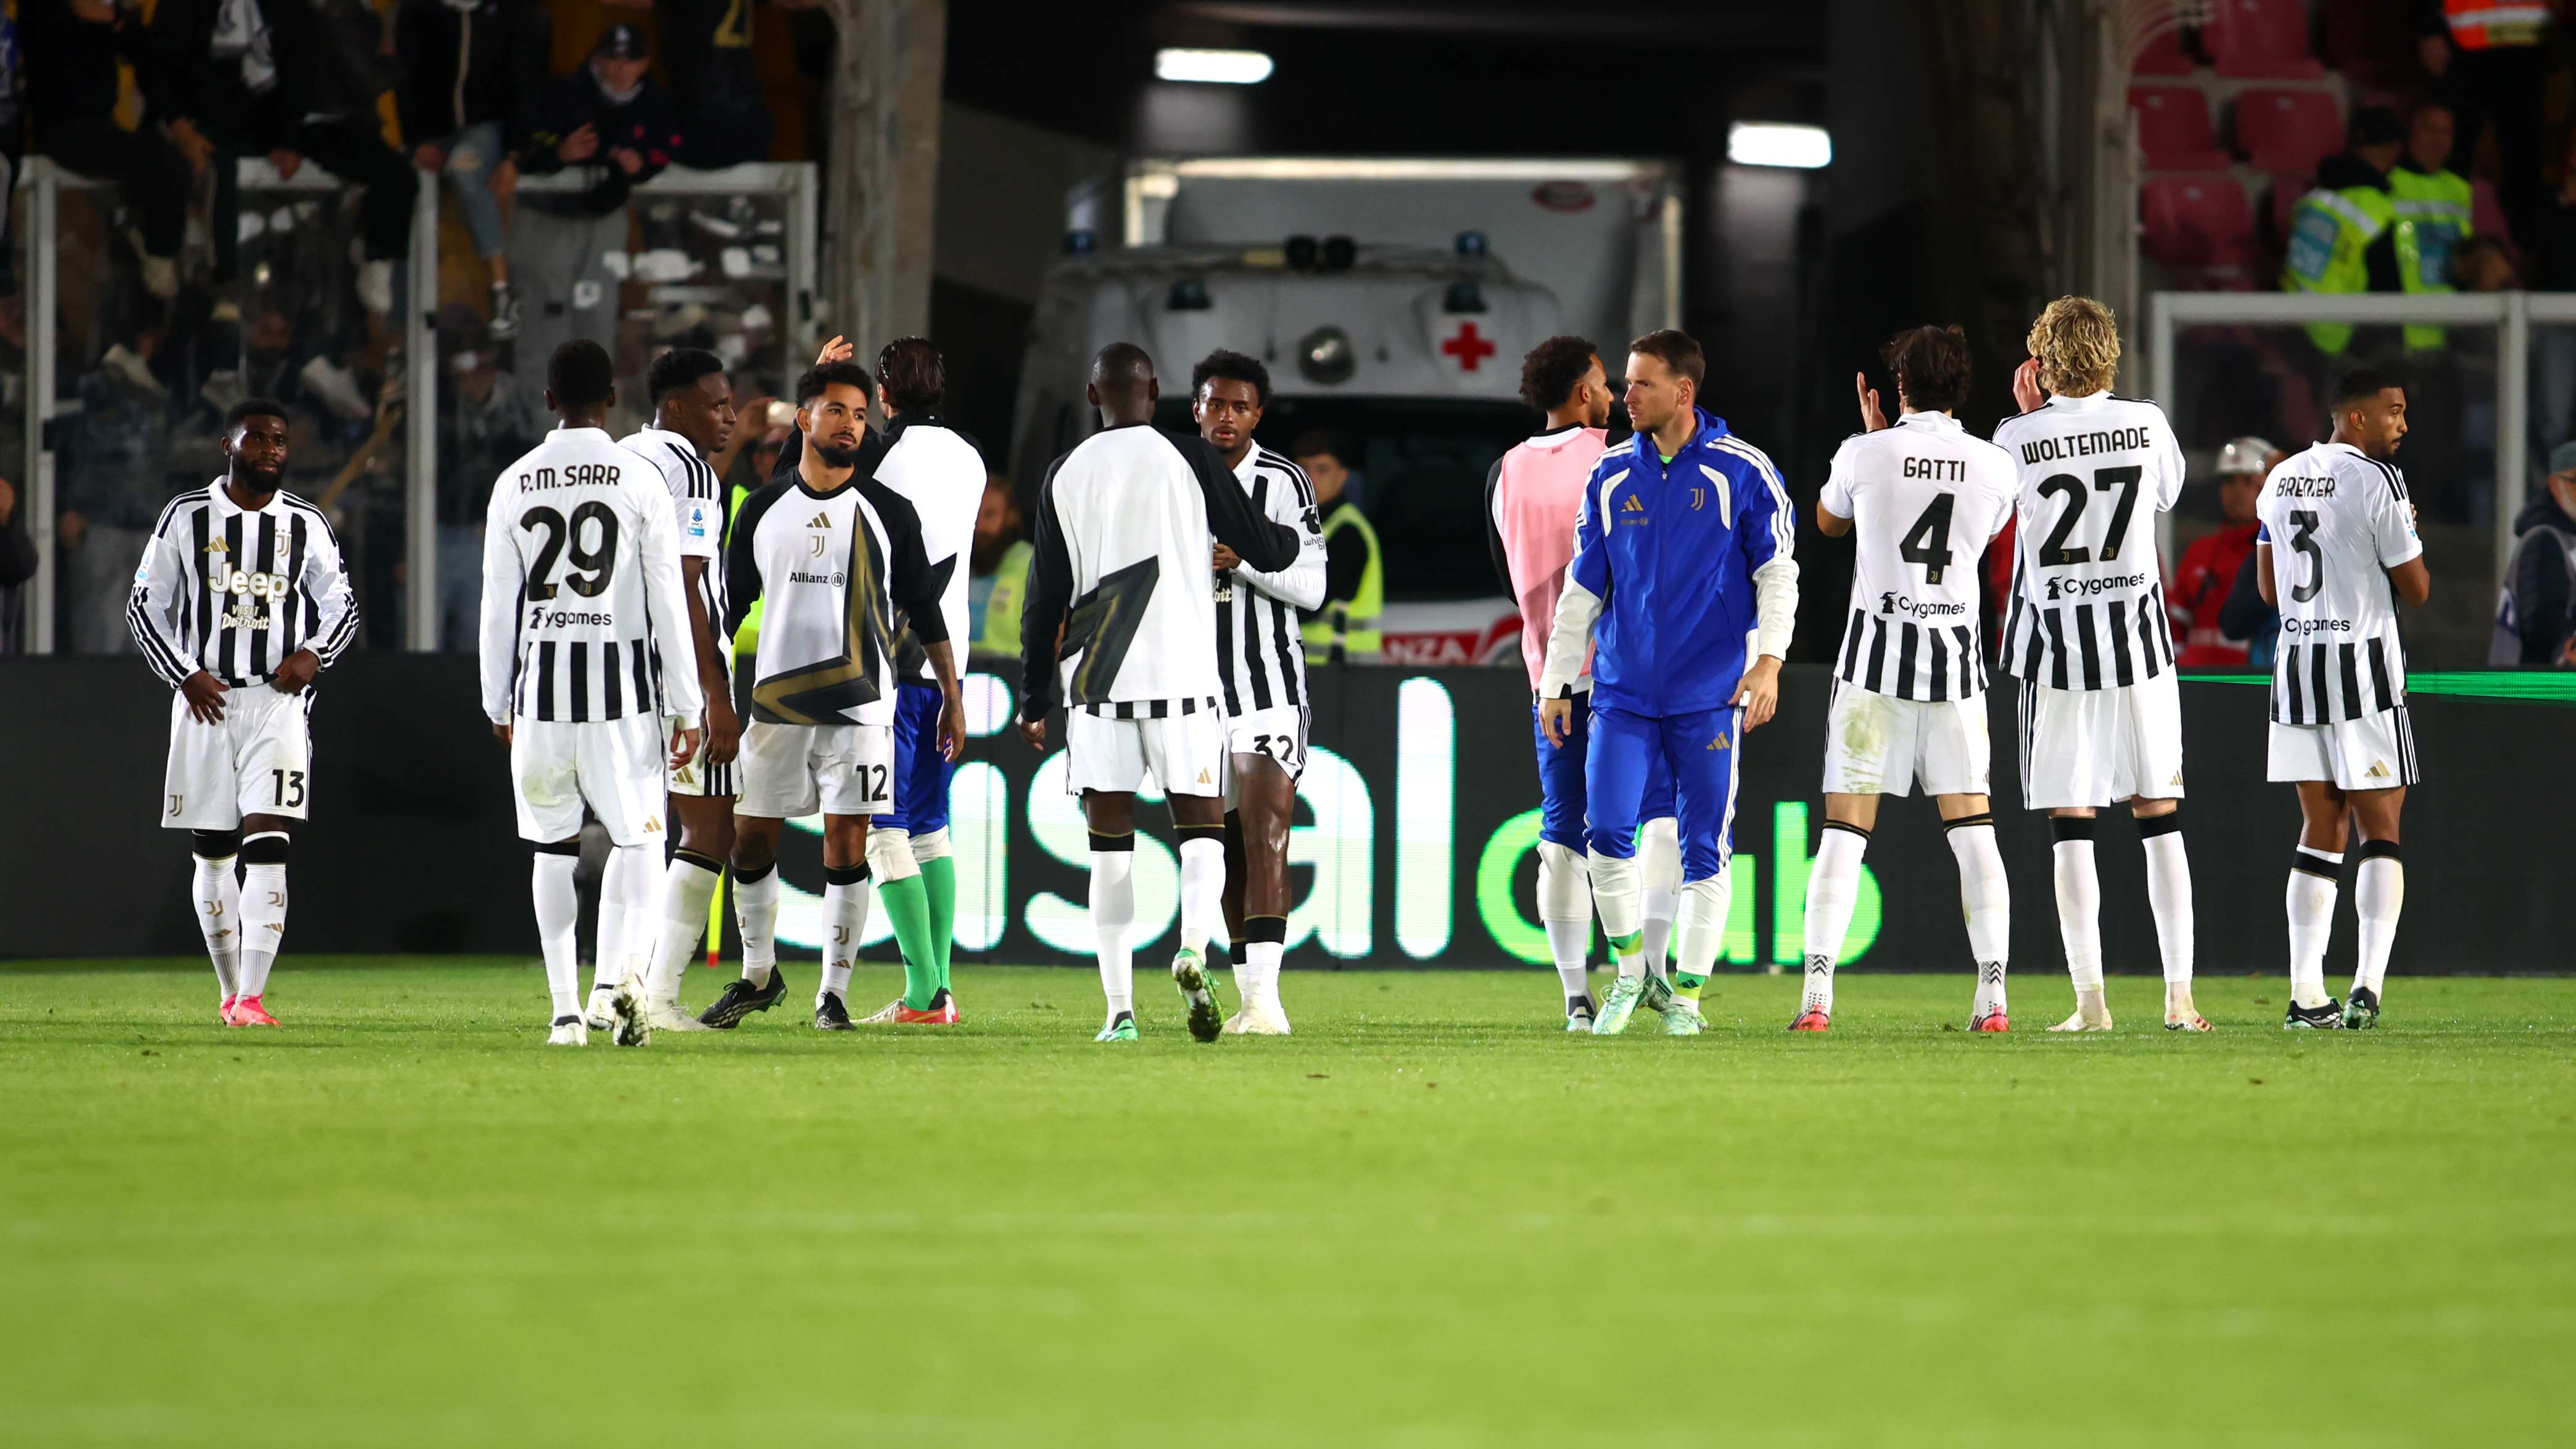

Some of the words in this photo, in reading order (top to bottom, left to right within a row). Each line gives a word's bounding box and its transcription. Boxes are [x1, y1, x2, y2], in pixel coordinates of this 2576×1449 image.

[2021, 427, 2150, 465] WOLTEMADE
[1904, 456, 1965, 482] GATTI
[2276, 477, 2335, 497] BREMER
[2037, 465, 2142, 568] 27
[520, 500, 619, 601] 29
[1899, 493, 1954, 585] 4
[2290, 510, 2324, 603] 3
[207, 562, 289, 603] Jeep
[790, 572, 828, 584] Allianz
[2064, 573, 2144, 595] Cygames
[232, 604, 260, 616] VISIT
[545, 611, 612, 628] ygames
[1899, 596, 1965, 619] Cygames
[221, 613, 270, 630] Detroit
[2285, 617, 2351, 636] Cygames
[1254, 734, 1294, 761] 32
[273, 769, 304, 808] 13
[856, 764, 888, 802] 12
